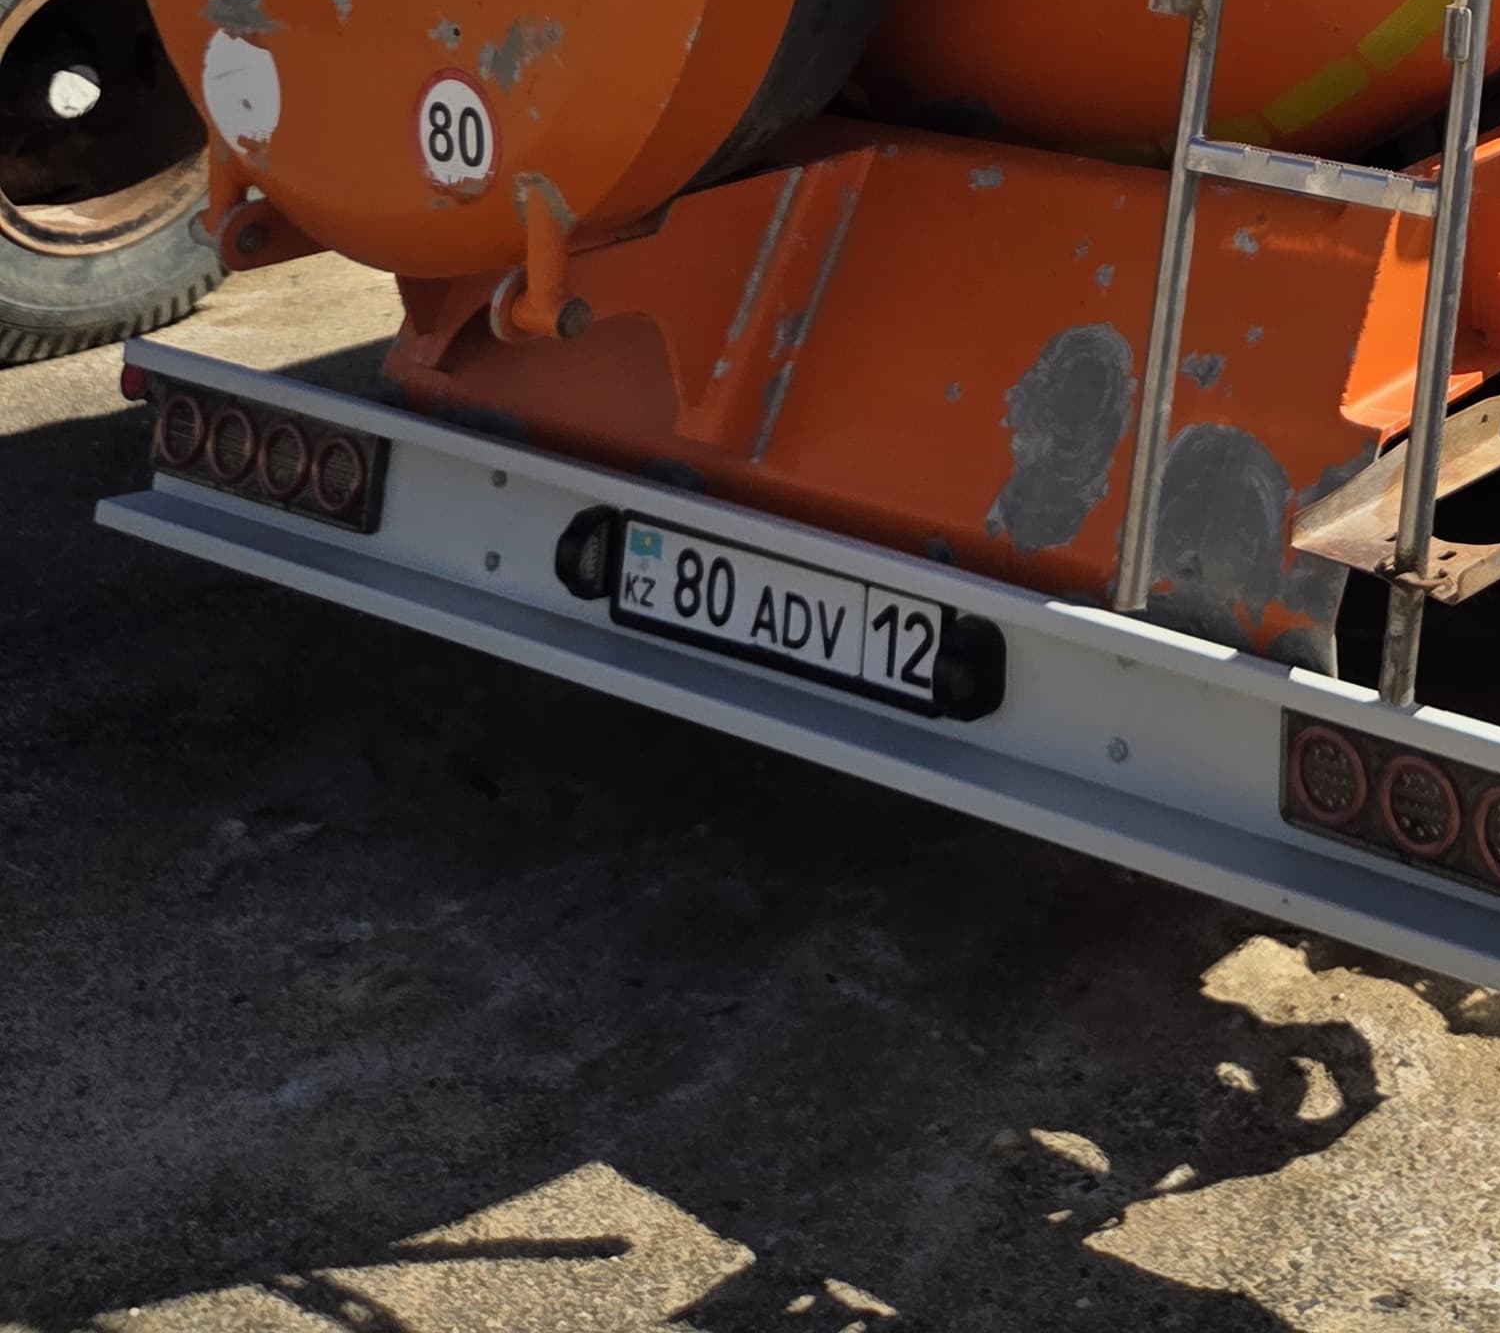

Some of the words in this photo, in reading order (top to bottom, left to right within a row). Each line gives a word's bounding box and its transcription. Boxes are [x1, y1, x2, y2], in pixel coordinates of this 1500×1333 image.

[428, 101, 485, 168] 80
[623, 571, 657, 608] KZ
[674, 549, 736, 627] 80
[750, 585, 846, 660] ADV
[872, 603, 936, 689] 12
